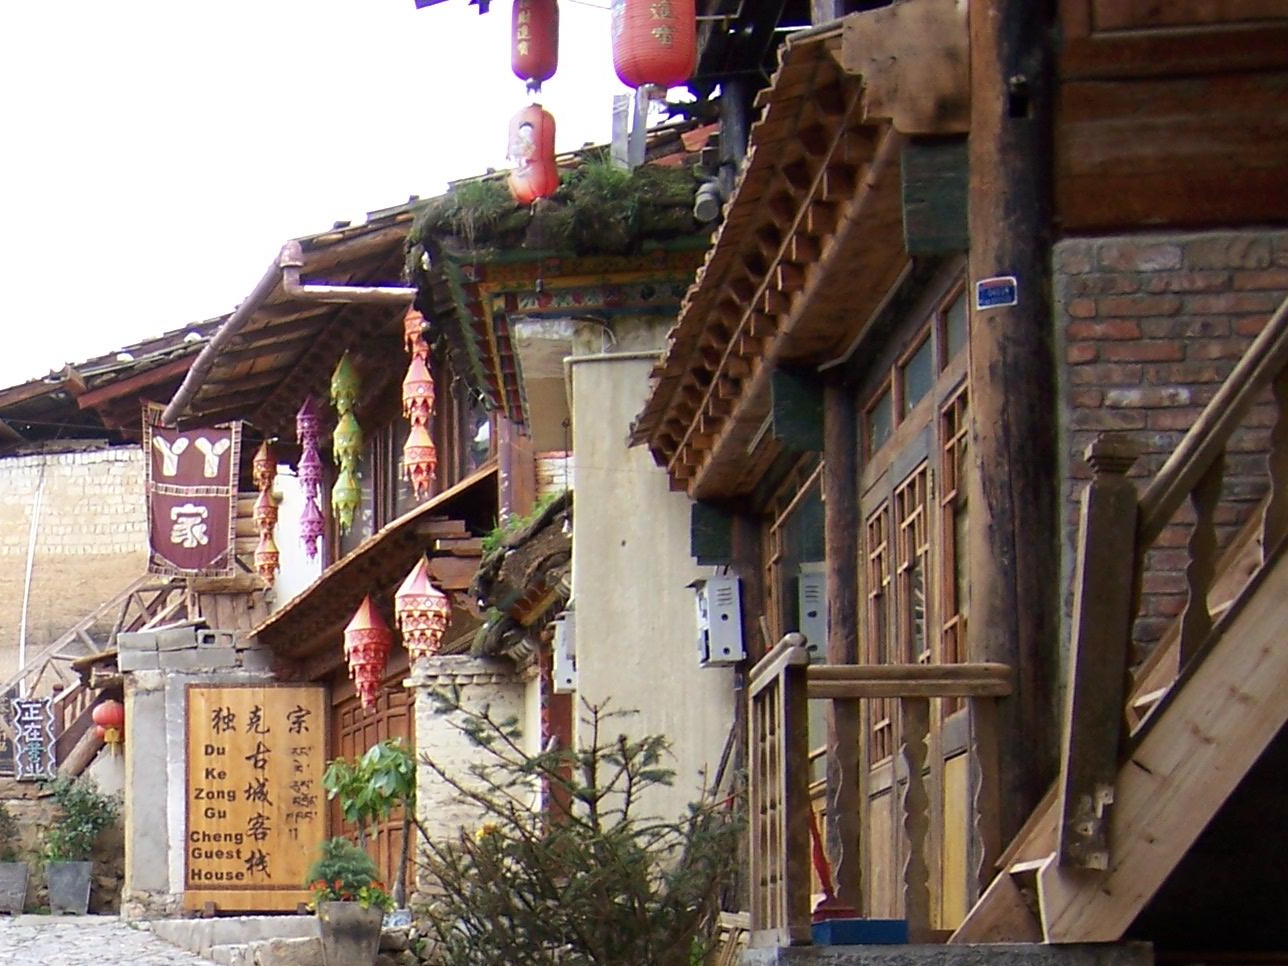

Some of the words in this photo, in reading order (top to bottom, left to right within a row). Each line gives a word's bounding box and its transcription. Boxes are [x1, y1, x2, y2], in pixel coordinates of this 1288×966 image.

[171, 503, 209, 548] 家
[211, 705, 312, 735] 独克宗
[204, 744, 226, 756] Du
[205, 768, 227, 780] Ke
[194, 788, 236, 801] Zong
[204, 807, 227, 819] Gu
[244, 741, 273, 879] 古城客栈
[190, 831, 244, 845] Cheng
[191, 848, 242, 860] Guest
[191, 869, 245, 881] House
